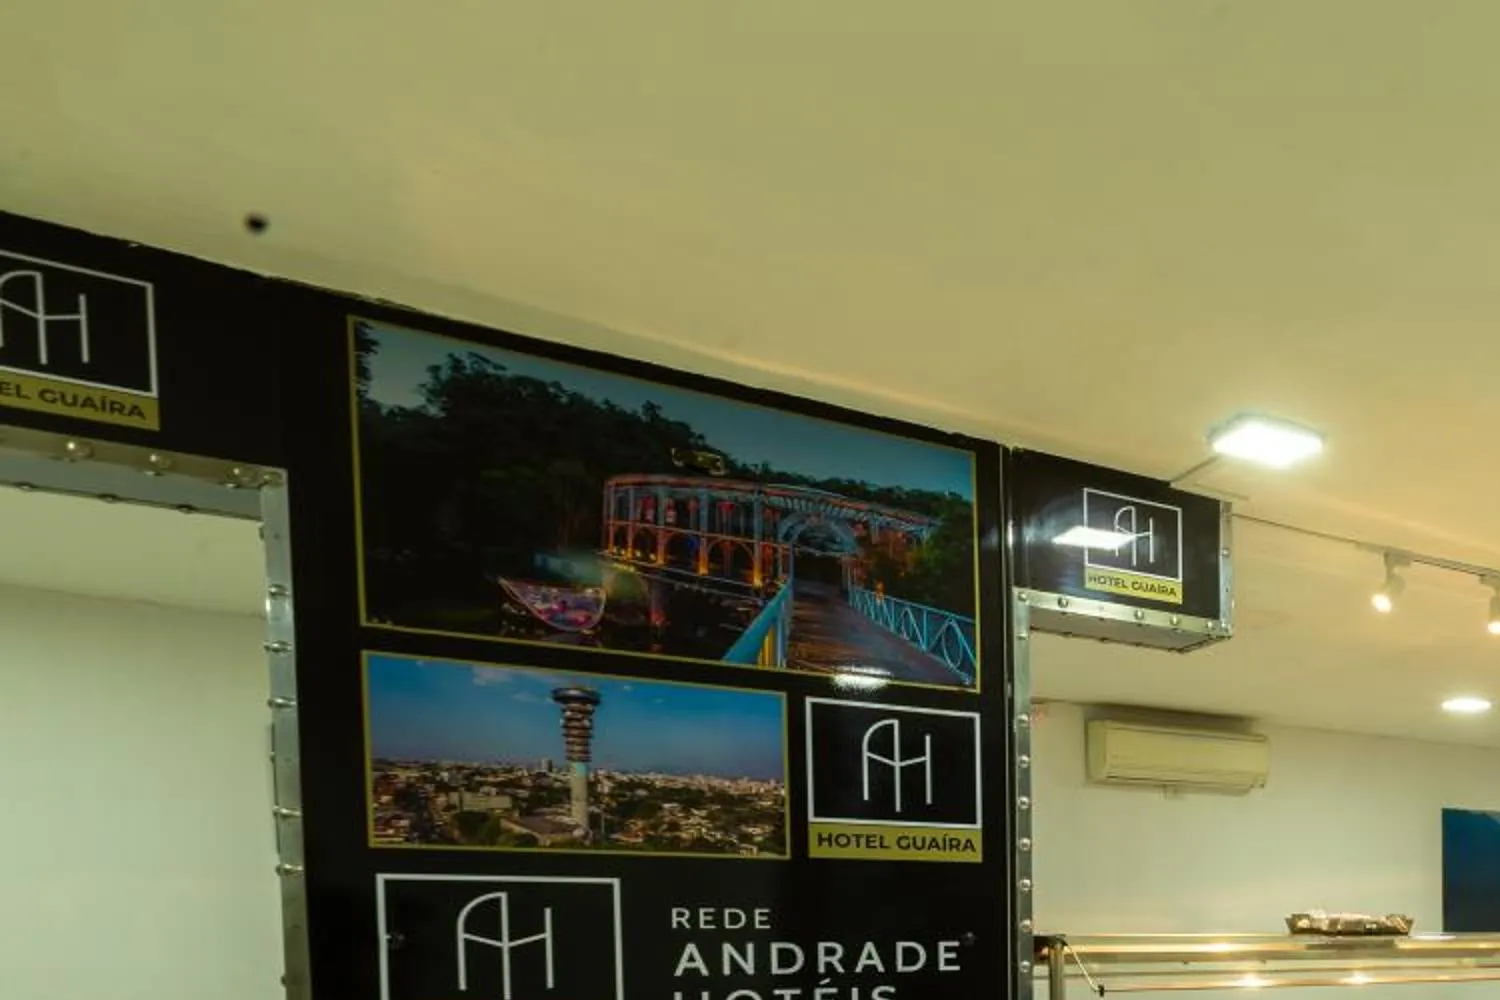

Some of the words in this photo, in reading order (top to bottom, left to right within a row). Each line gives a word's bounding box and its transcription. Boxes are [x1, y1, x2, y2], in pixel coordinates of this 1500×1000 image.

[38, 387, 146, 420] GUAÍRA
[816, 831, 891, 851] HOTEL
[897, 832, 977, 854] GUAÍRA
[671, 907, 772, 930] REDE
[673, 940, 962, 977] ANDRADE
